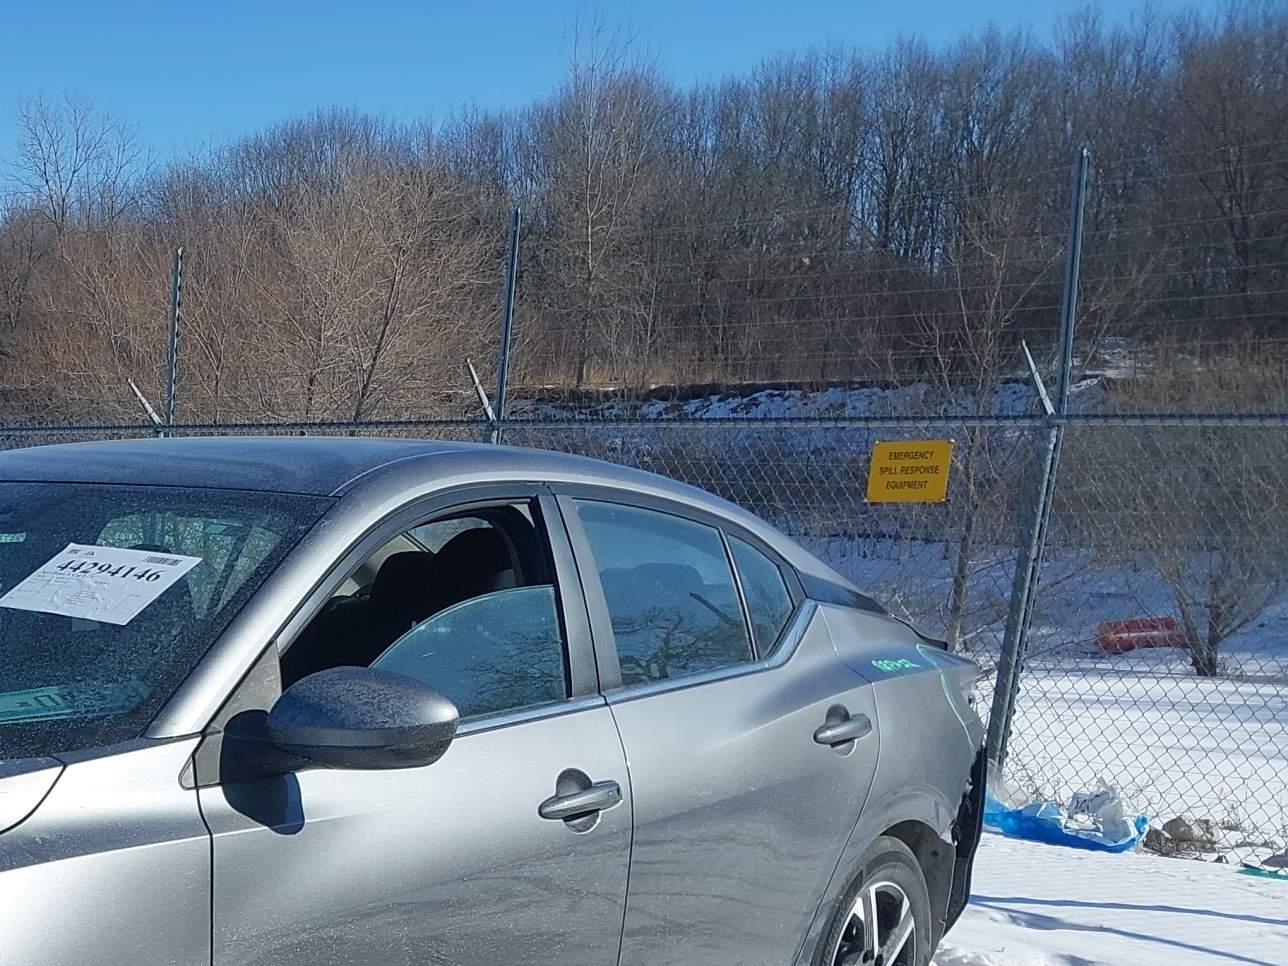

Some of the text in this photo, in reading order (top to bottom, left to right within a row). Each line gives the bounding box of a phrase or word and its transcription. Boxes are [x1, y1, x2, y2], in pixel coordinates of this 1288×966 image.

[888, 450, 934, 461] EMERGENCY
[879, 465, 940, 476] SPILL RESPONSE
[886, 480, 928, 490] EQUIPMENT
[56, 559, 165, 583] 44294146
